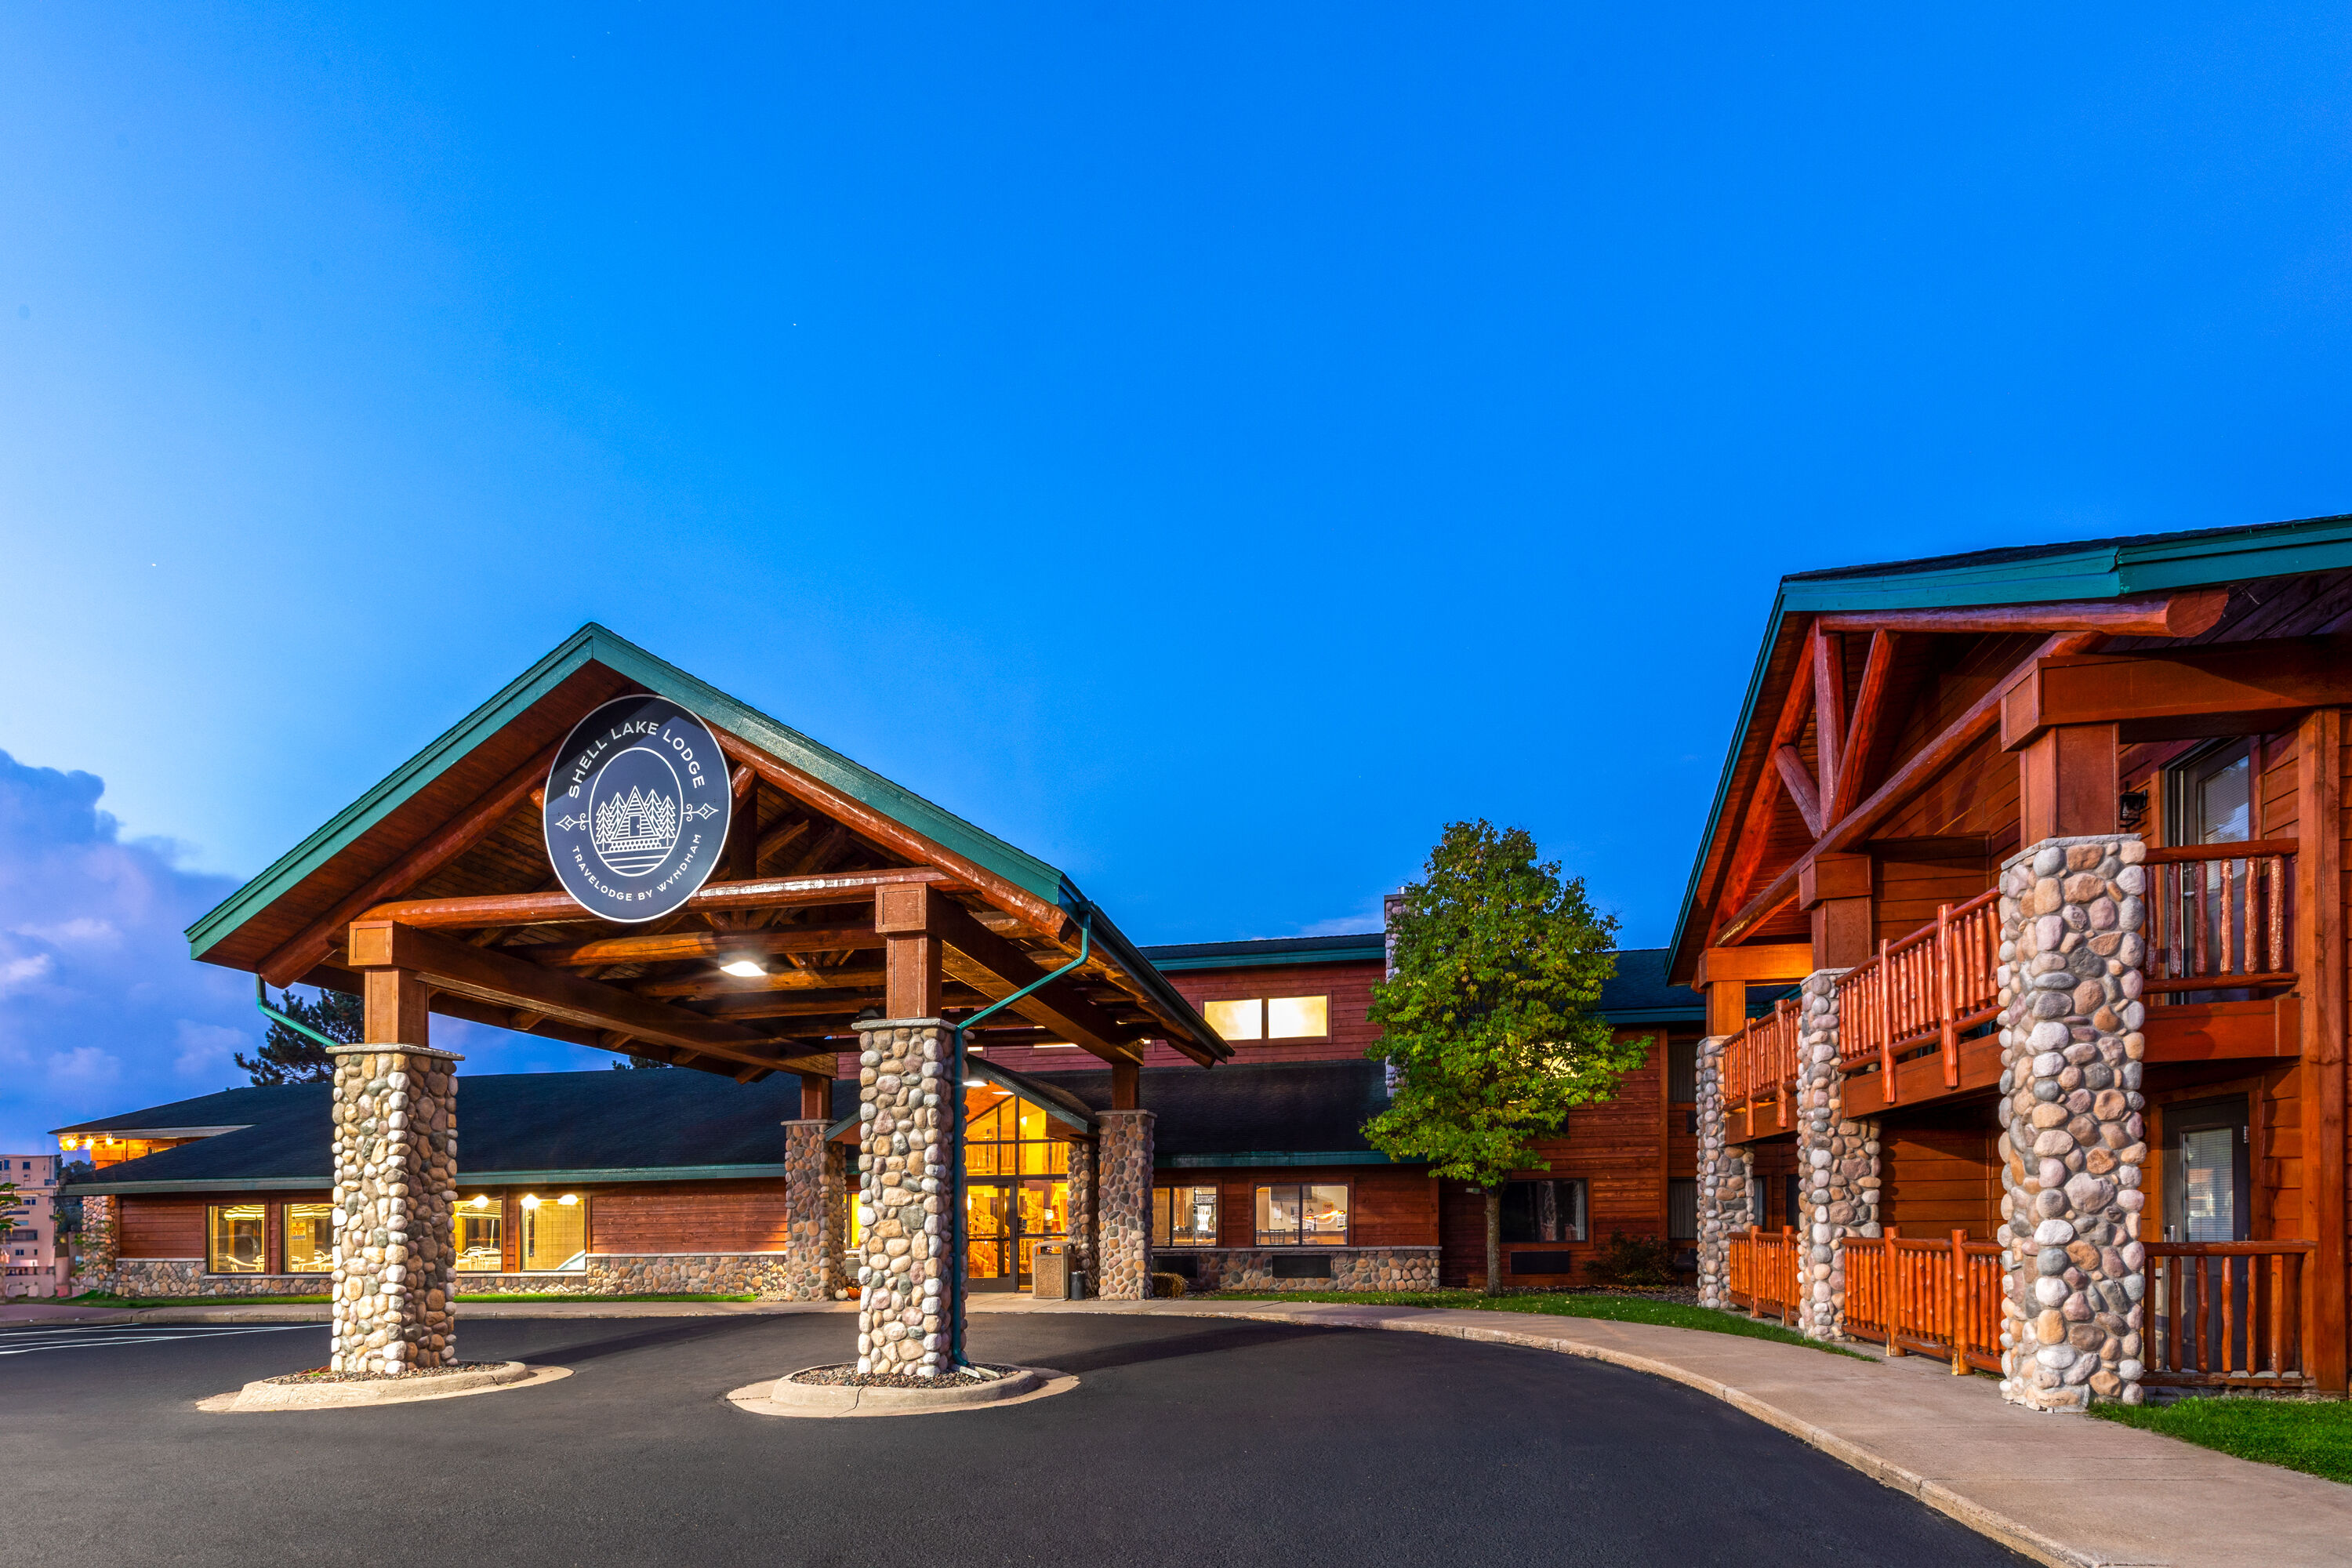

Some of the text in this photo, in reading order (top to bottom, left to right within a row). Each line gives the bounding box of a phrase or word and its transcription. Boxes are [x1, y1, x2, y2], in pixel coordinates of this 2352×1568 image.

[569, 720, 705, 798] SHELL LAKE LODGE
[572, 833, 702, 901] TRAVELODGE BY WYNDHAM
